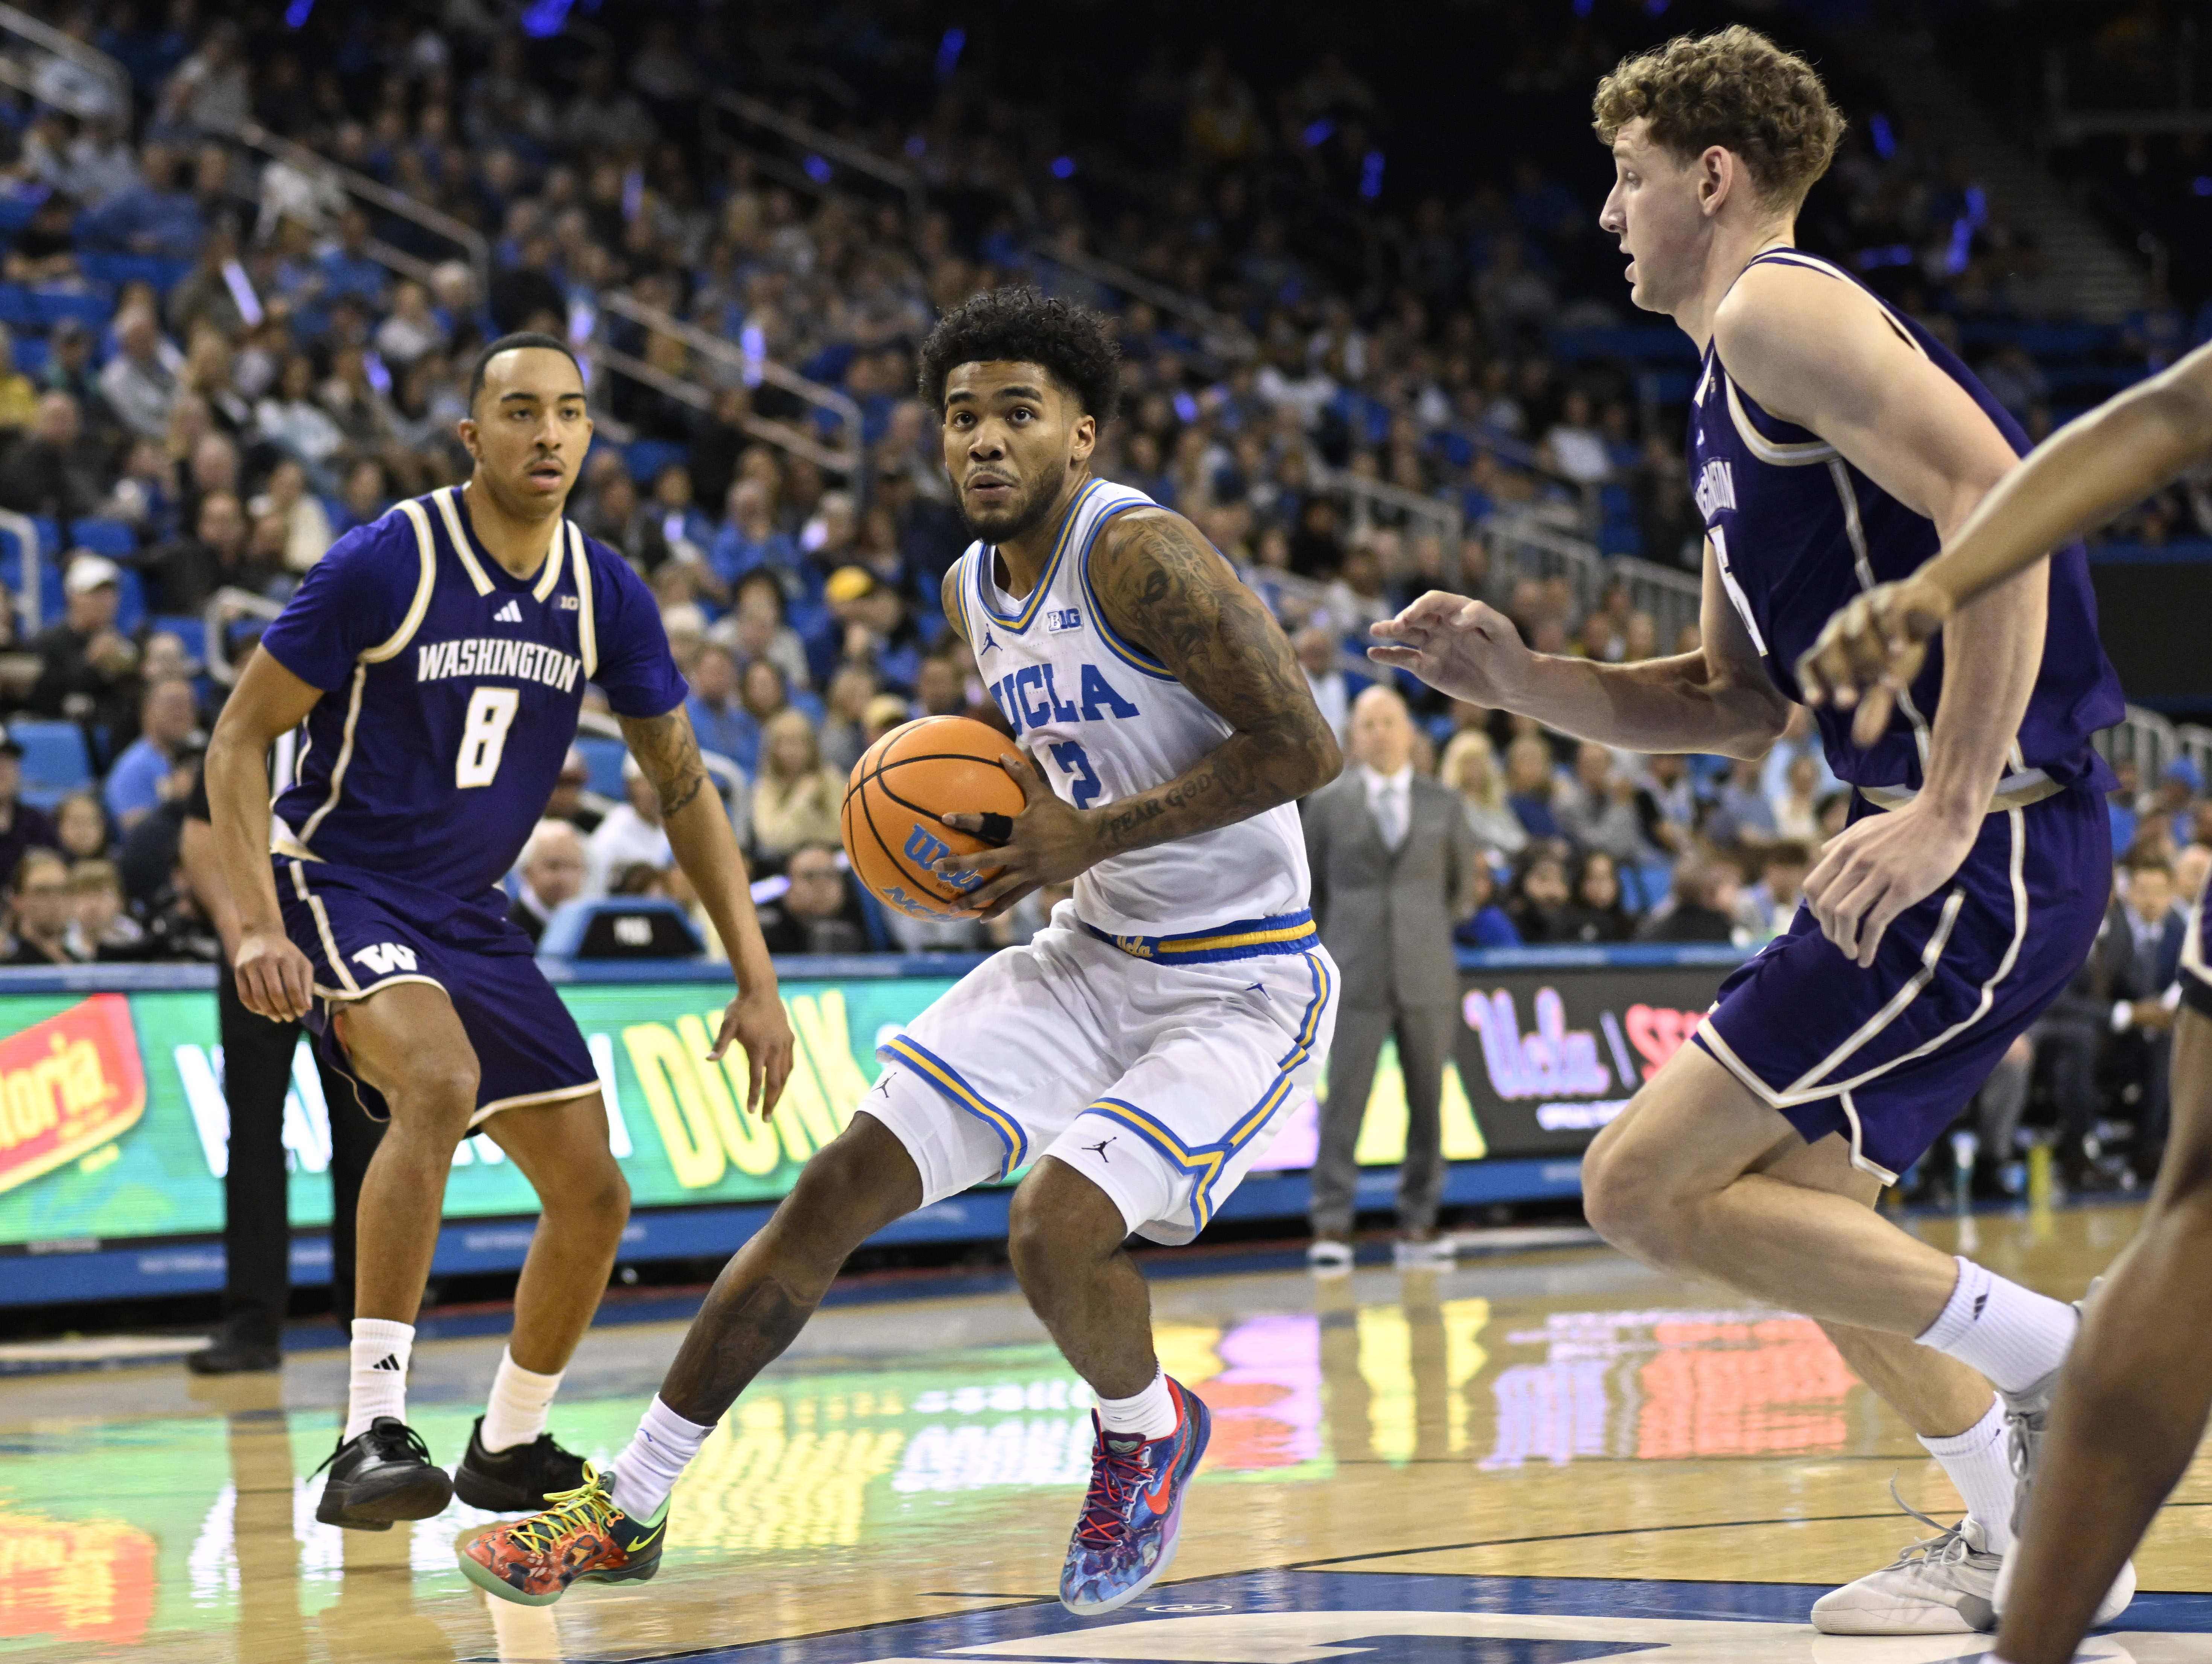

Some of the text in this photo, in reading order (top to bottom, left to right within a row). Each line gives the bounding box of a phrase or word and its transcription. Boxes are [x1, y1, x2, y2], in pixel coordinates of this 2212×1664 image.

[418, 639, 581, 693] WASHINGTON
[989, 663, 1141, 736] UCLA
[456, 686, 520, 788] 8
[1049, 741, 1101, 810] 2
[1165, 773, 1212, 808] GOD
[351, 942, 418, 974] W
